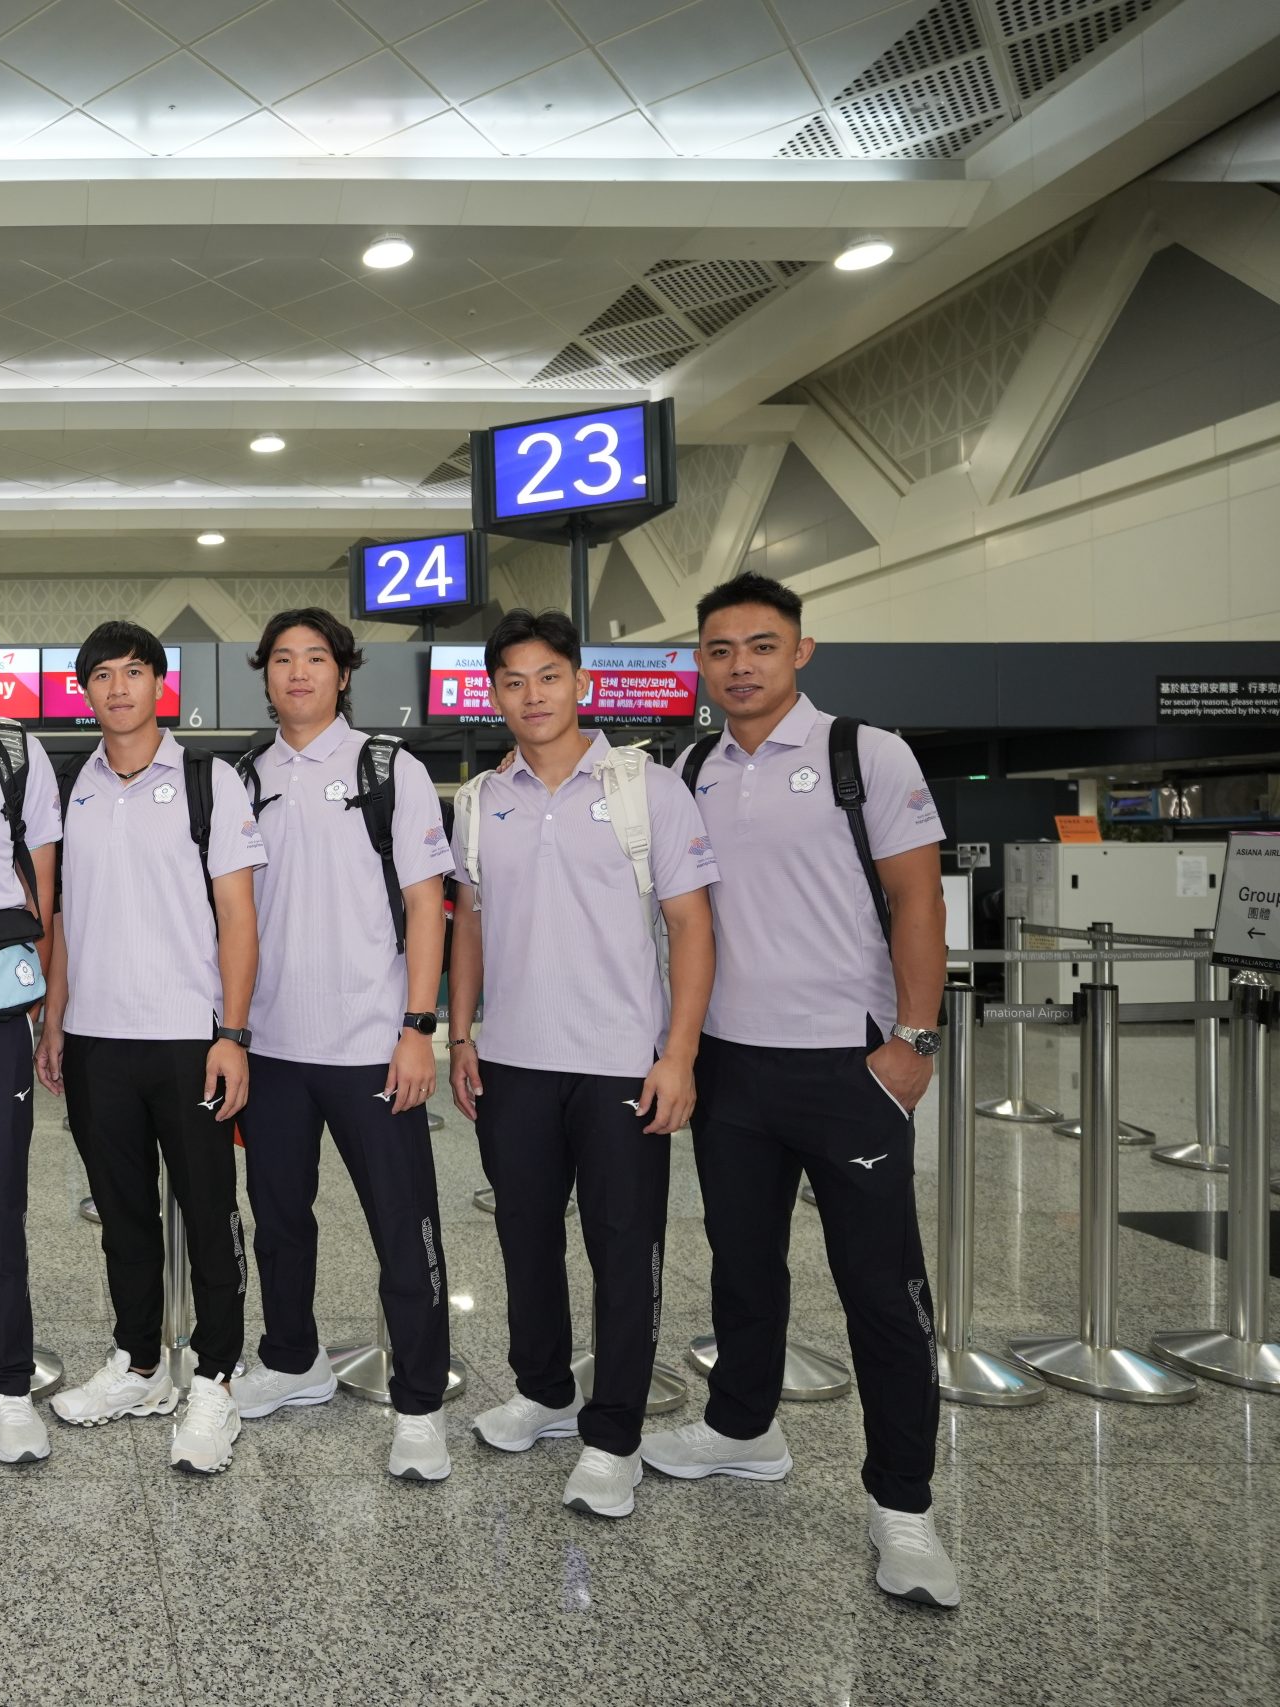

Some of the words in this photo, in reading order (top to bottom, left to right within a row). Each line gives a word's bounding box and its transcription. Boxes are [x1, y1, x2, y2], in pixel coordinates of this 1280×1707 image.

[516, 422, 621, 505] 23
[377, 544, 453, 604] 24
[592, 659, 624, 668] ASIANA
[627, 660, 667, 668] AIRLINES
[463, 688, 489, 698] Group
[599, 689, 624, 699] Group
[626, 689, 688, 699] Internet/Mobile
[1173, 698, 1200, 707] security
[1231, 698, 1253, 707] please
[400, 707, 412, 727] 7
[699, 705, 711, 726] 8
[1173, 708, 1202, 717] properly
[1203, 707, 1237, 717] inspected
[1238, 707, 1247, 717] by
[1248, 707, 1260, 715] the
[189, 708, 202, 728] 6
[1264, 849, 1280, 857] AIRL
[1099, 952, 1130, 961] Taoyuan
[1132, 951, 1181, 959] International
[1183, 950, 1210, 960] Airport
[1038, 1008, 1073, 1021] Airpor
